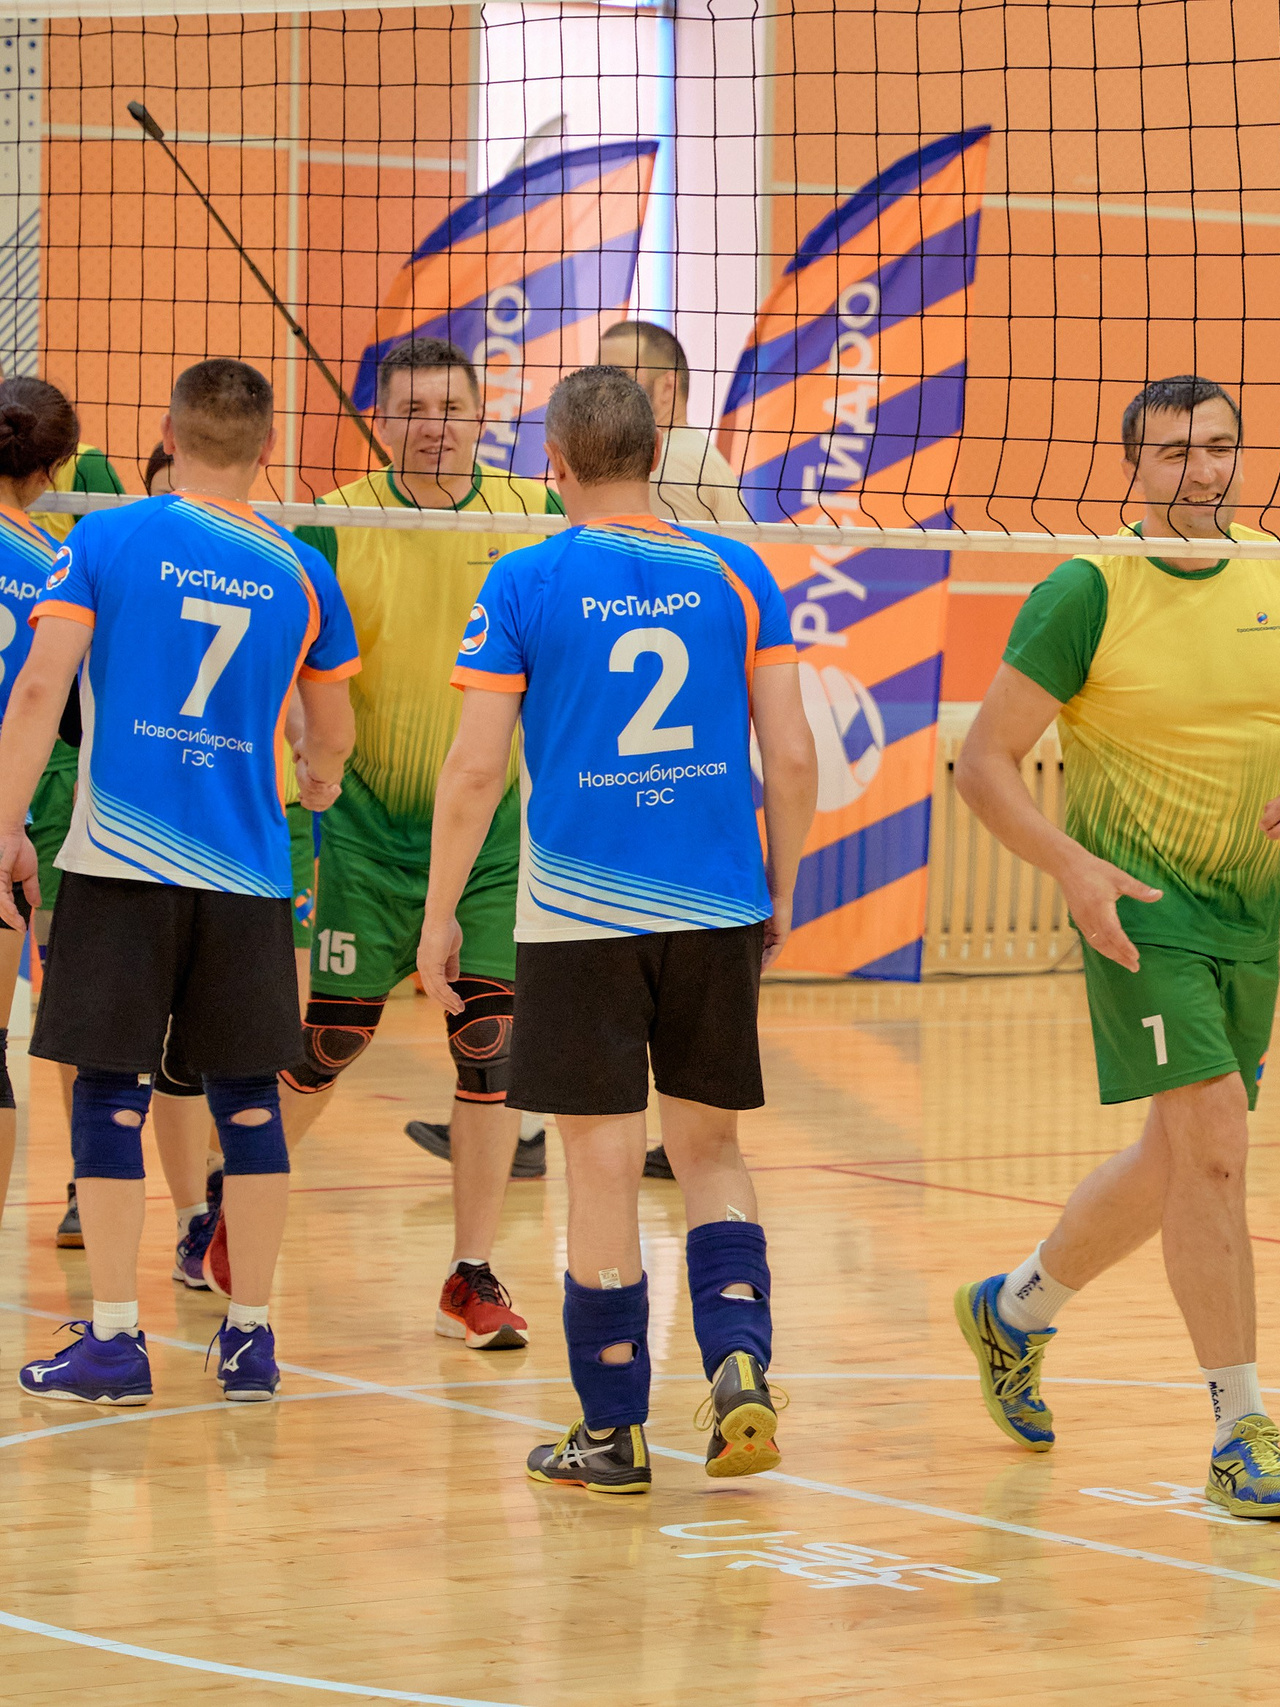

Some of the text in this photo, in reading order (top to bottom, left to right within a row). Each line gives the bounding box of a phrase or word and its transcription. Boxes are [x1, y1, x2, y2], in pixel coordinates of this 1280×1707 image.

[790, 281, 884, 648] РусГидро
[161, 561, 274, 600] РусГидро
[582, 590, 701, 622] РусГидро
[179, 596, 251, 718] 7
[608, 627, 694, 757] 2
[182, 749, 214, 768] ГЭС
[578, 762, 727, 788] Новосибирская
[636, 788, 675, 807] ГЭС
[317, 928, 357, 976] 15
[1141, 1014, 1168, 1066] 1
